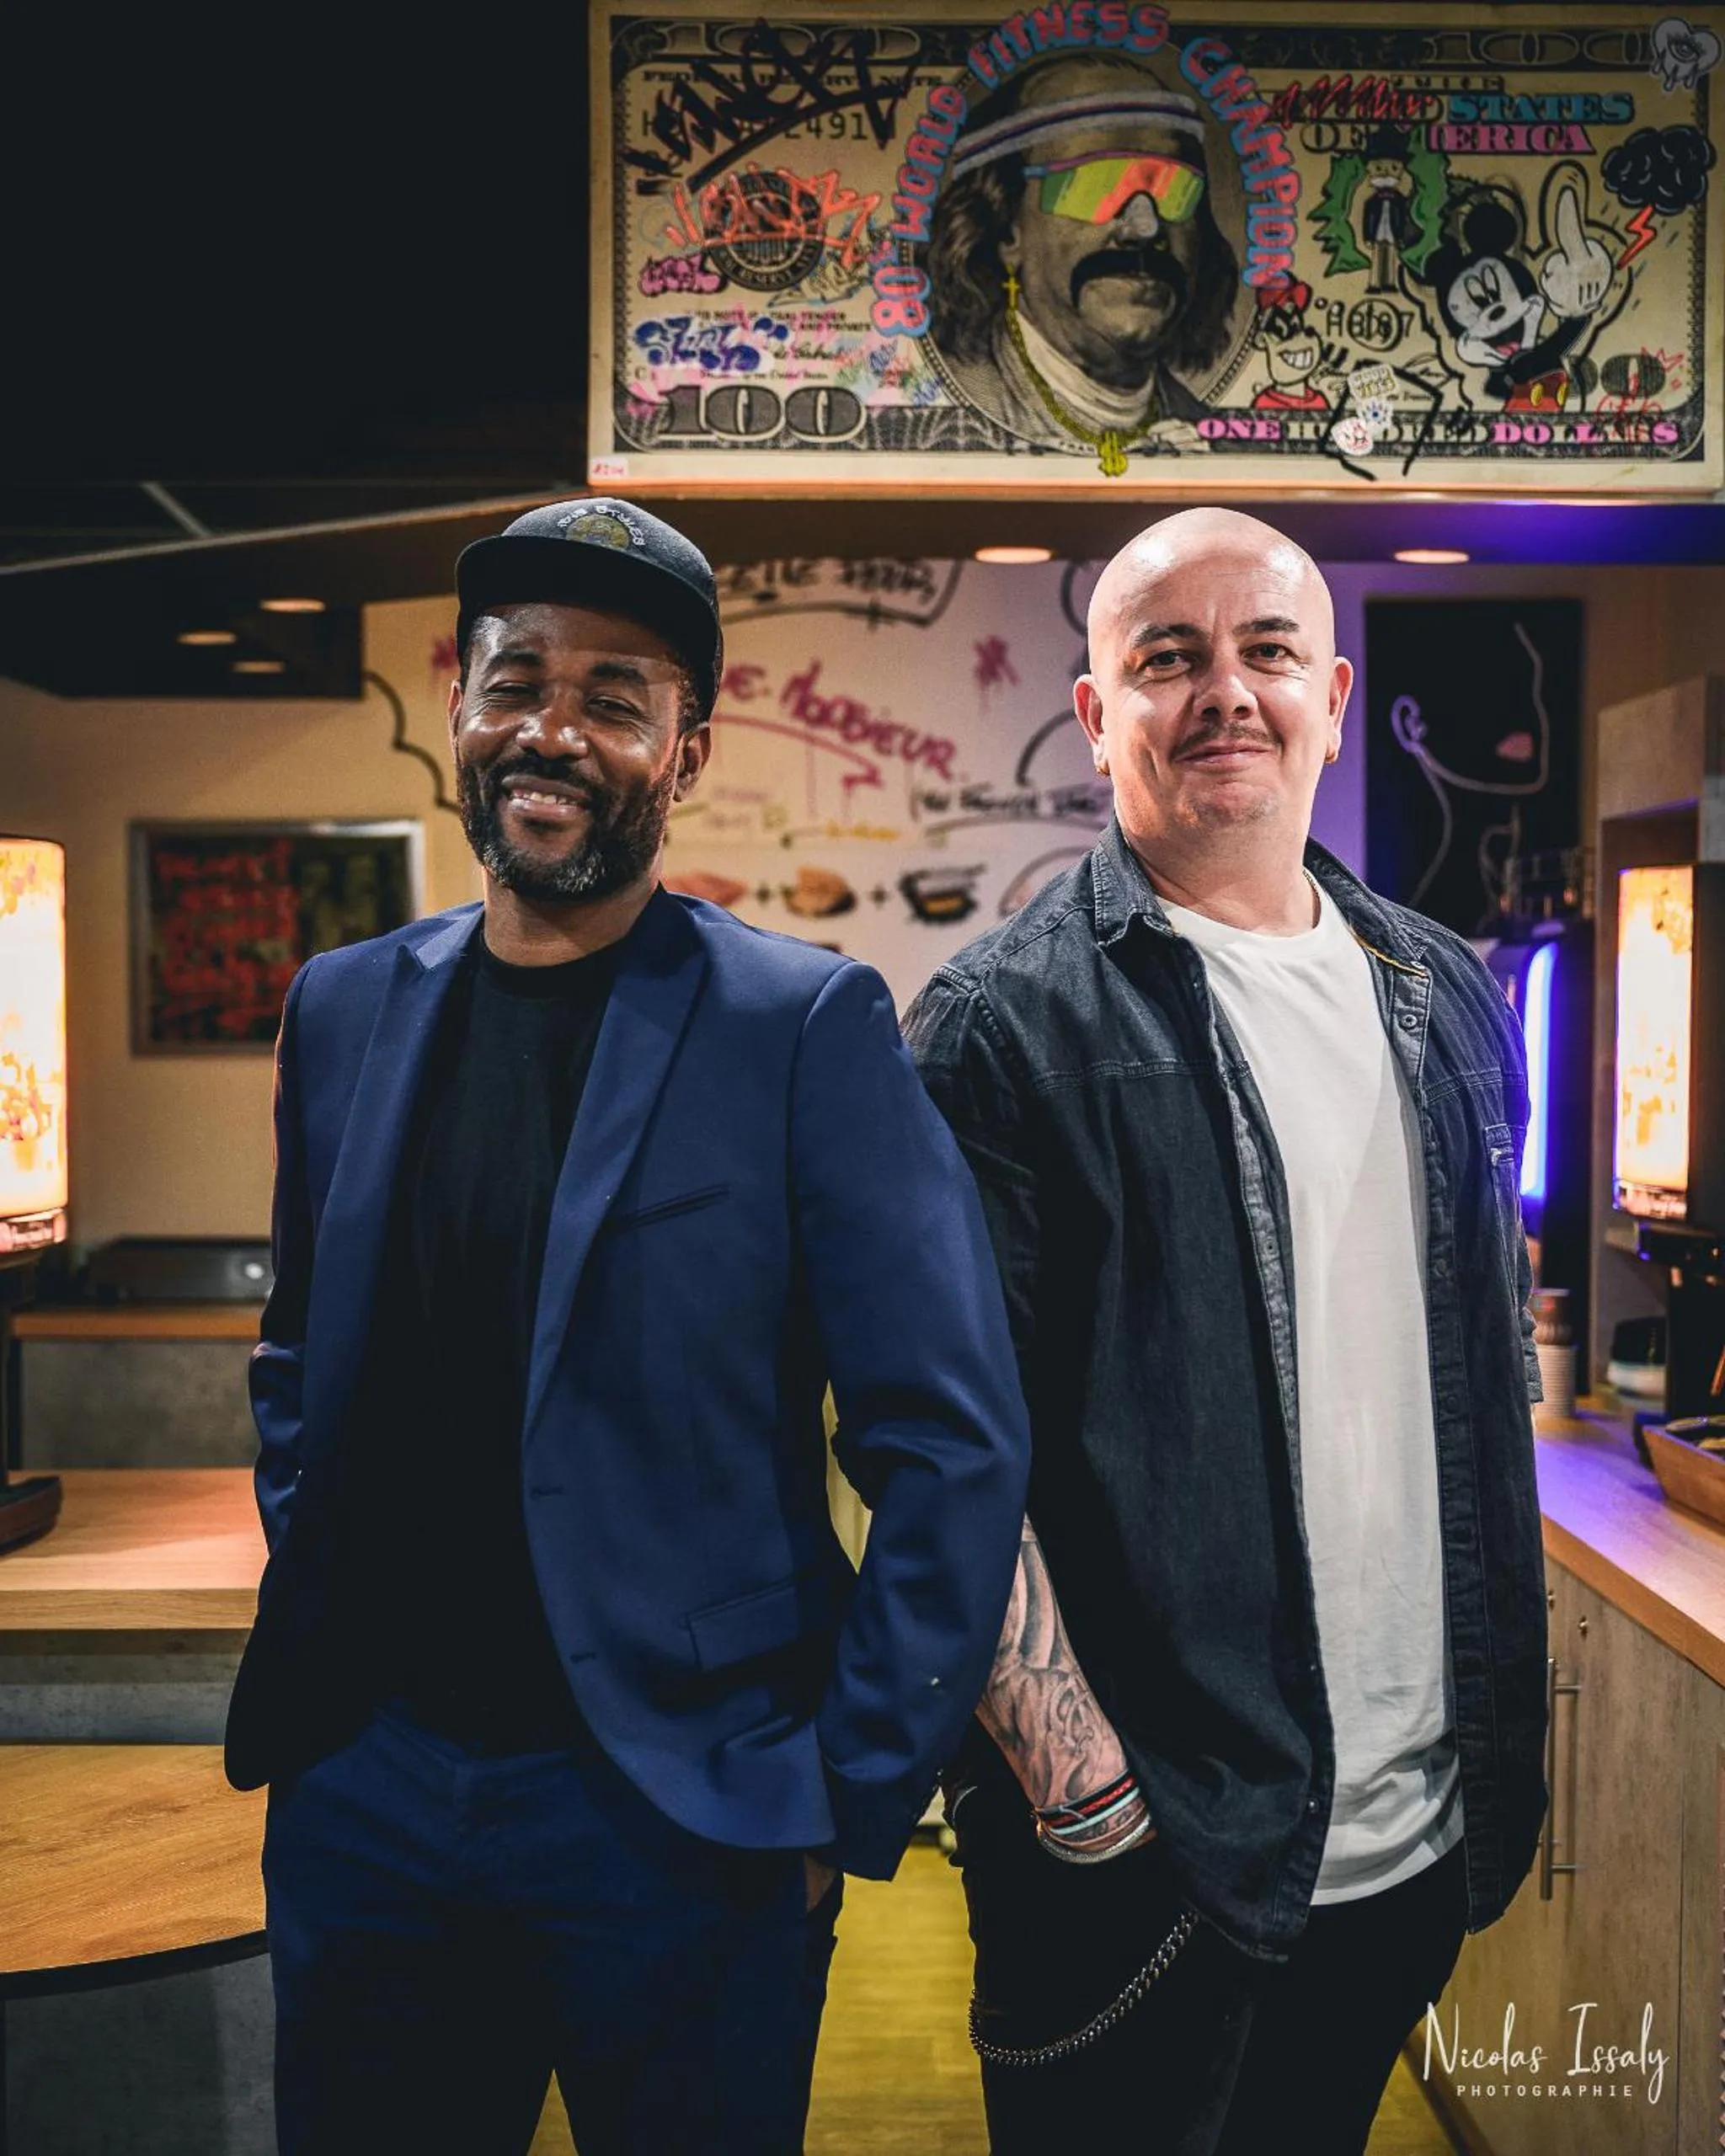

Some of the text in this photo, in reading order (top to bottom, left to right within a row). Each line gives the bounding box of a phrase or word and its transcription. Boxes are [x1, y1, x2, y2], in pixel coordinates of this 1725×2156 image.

[1448, 93, 1635, 125] STATES
[890, 85, 970, 243] WORLD
[968, 0, 1171, 89] FITNESS
[1179, 36, 1302, 291] CHAMPION
[1300, 123, 1597, 155] OF ERICA
[658, 384, 865, 440] 100
[1196, 417, 1282, 440] ONE
[1491, 422, 1680, 445] DOLLARS
